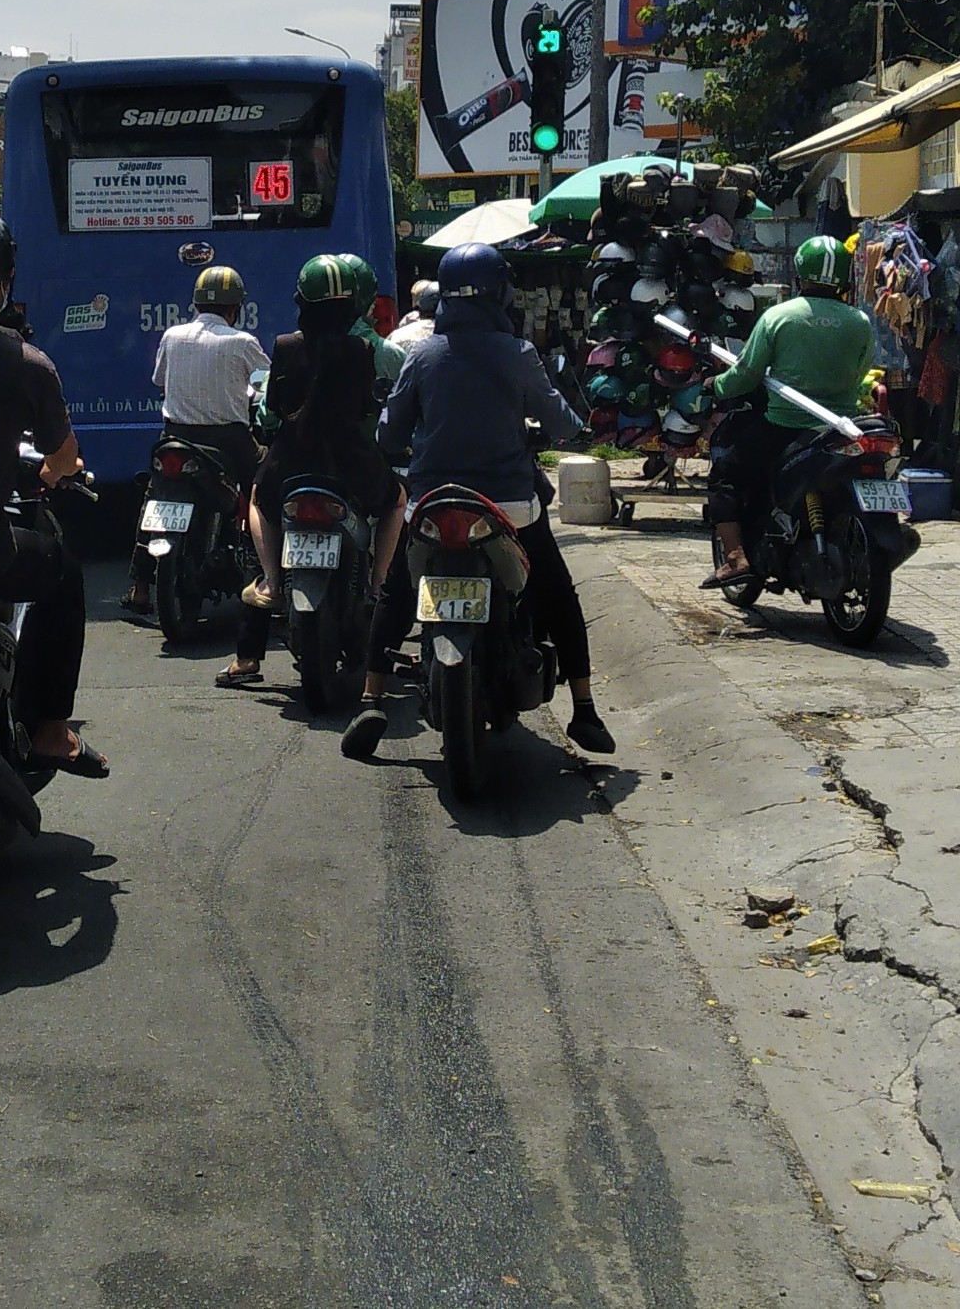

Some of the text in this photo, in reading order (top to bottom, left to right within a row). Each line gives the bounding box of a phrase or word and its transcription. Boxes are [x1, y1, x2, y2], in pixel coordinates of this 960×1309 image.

[539, 30, 560, 52] 29
[121, 105, 265, 127] SaigonBus
[117, 161, 162, 173] SaigonBus
[93, 171, 187, 189] TUYỂN DỤNG
[253, 163, 291, 202] 45
[87, 215, 195, 227] Hotline: 028 39 505 505
[67, 306, 92, 316] GAS
[65, 314, 105, 325] SOUTH
[90, 398, 111, 413] LỖI
[115, 398, 133, 412] ĐÃ
[861, 482, 900, 496] 59-T2
[153, 503, 185, 517] 67-K1
[862, 497, 908, 510] 577.86
[292, 533, 332, 551] 37-P1
